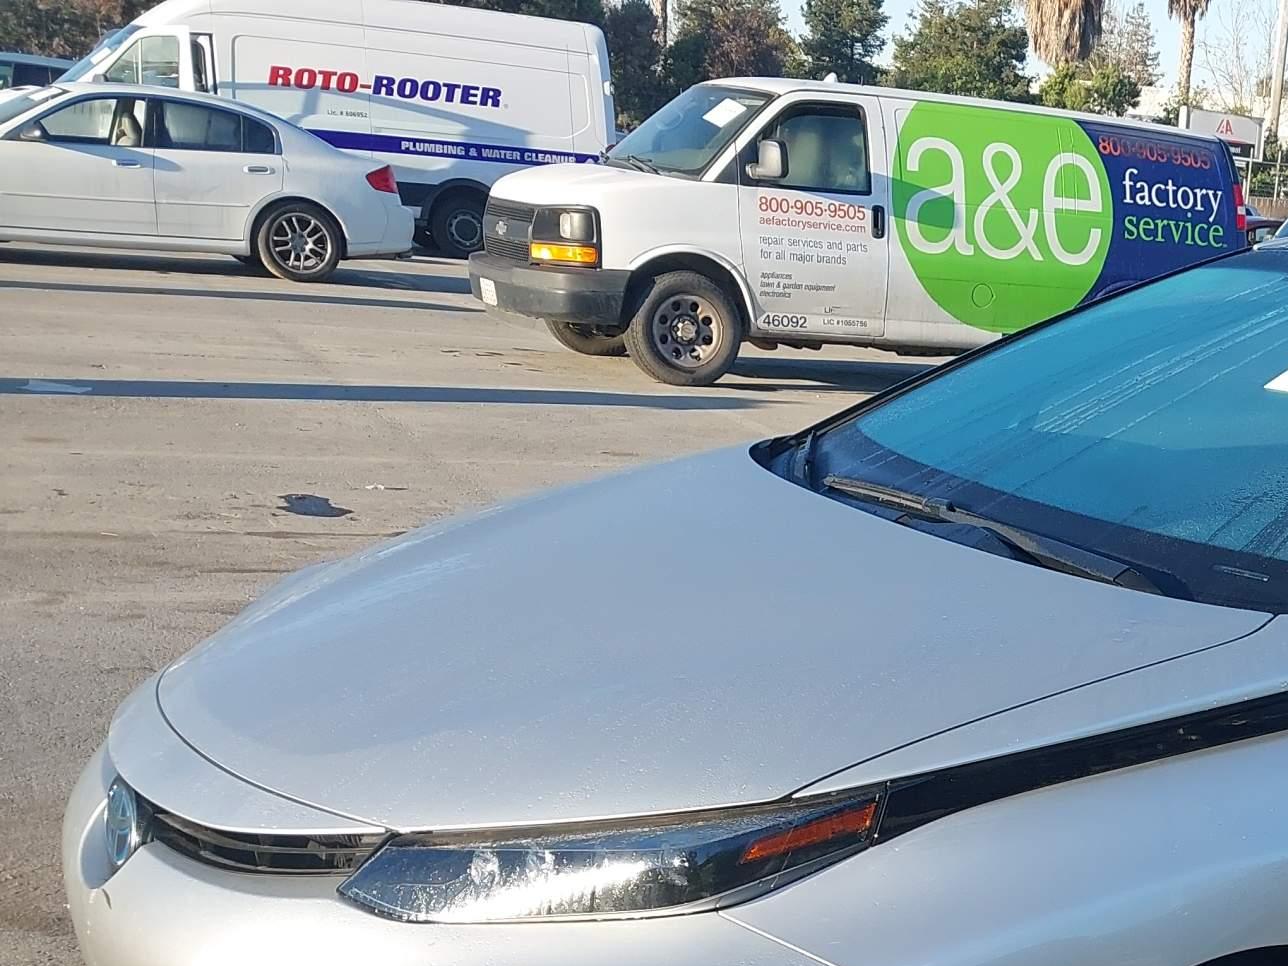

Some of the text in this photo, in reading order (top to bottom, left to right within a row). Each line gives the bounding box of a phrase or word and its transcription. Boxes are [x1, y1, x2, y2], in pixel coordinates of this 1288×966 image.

[268, 65, 502, 108] ROTO-ROOTER
[401, 141, 465, 155] PLUMBING
[469, 147, 478, 156] &
[482, 148, 520, 160] WATER
[905, 136, 1103, 266] a&e
[1122, 168, 1222, 223] factory
[759, 215, 867, 234] aefactoryservice.com
[1124, 212, 1224, 248] service
[759, 234, 869, 254] repair services and parts
[760, 248, 847, 266] for all major brands
[762, 313, 808, 329] 46092
